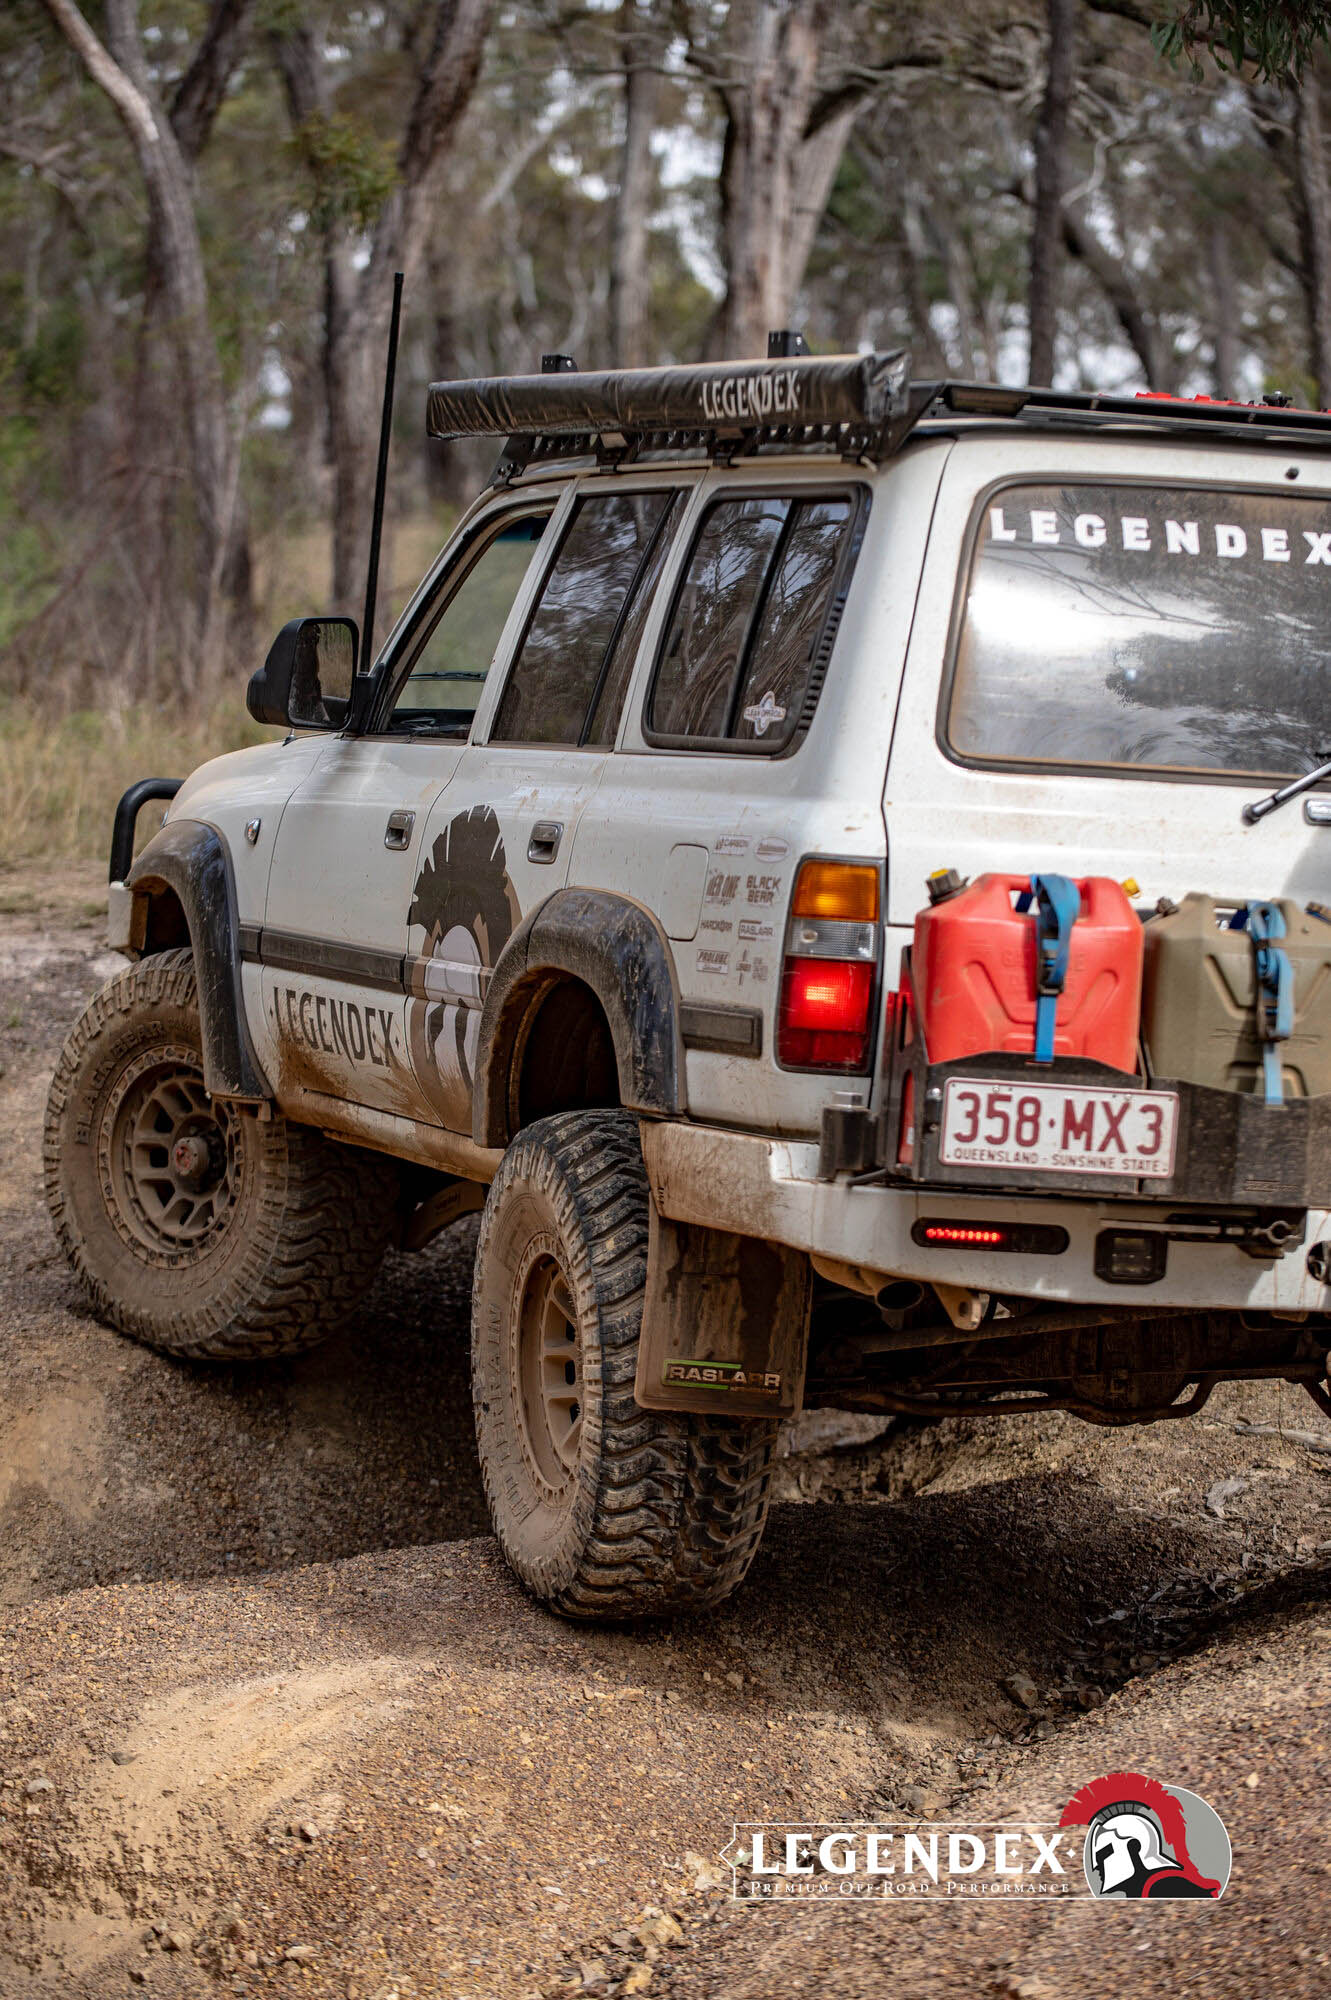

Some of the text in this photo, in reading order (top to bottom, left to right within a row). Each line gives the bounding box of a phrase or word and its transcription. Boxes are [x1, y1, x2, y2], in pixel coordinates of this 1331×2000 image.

[702, 369, 799, 423] LEGENDEX
[989, 507, 1331, 565] LEGENDEX
[746, 874, 781, 892] BLACK
[747, 889, 775, 906] BEAR
[273, 986, 396, 1072] LEGENDEX
[954, 1147, 1039, 1165] QUEENSLAND
[1052, 1153, 1115, 1170] SUNSHINE
[1121, 1158, 1165, 1172] STATE
